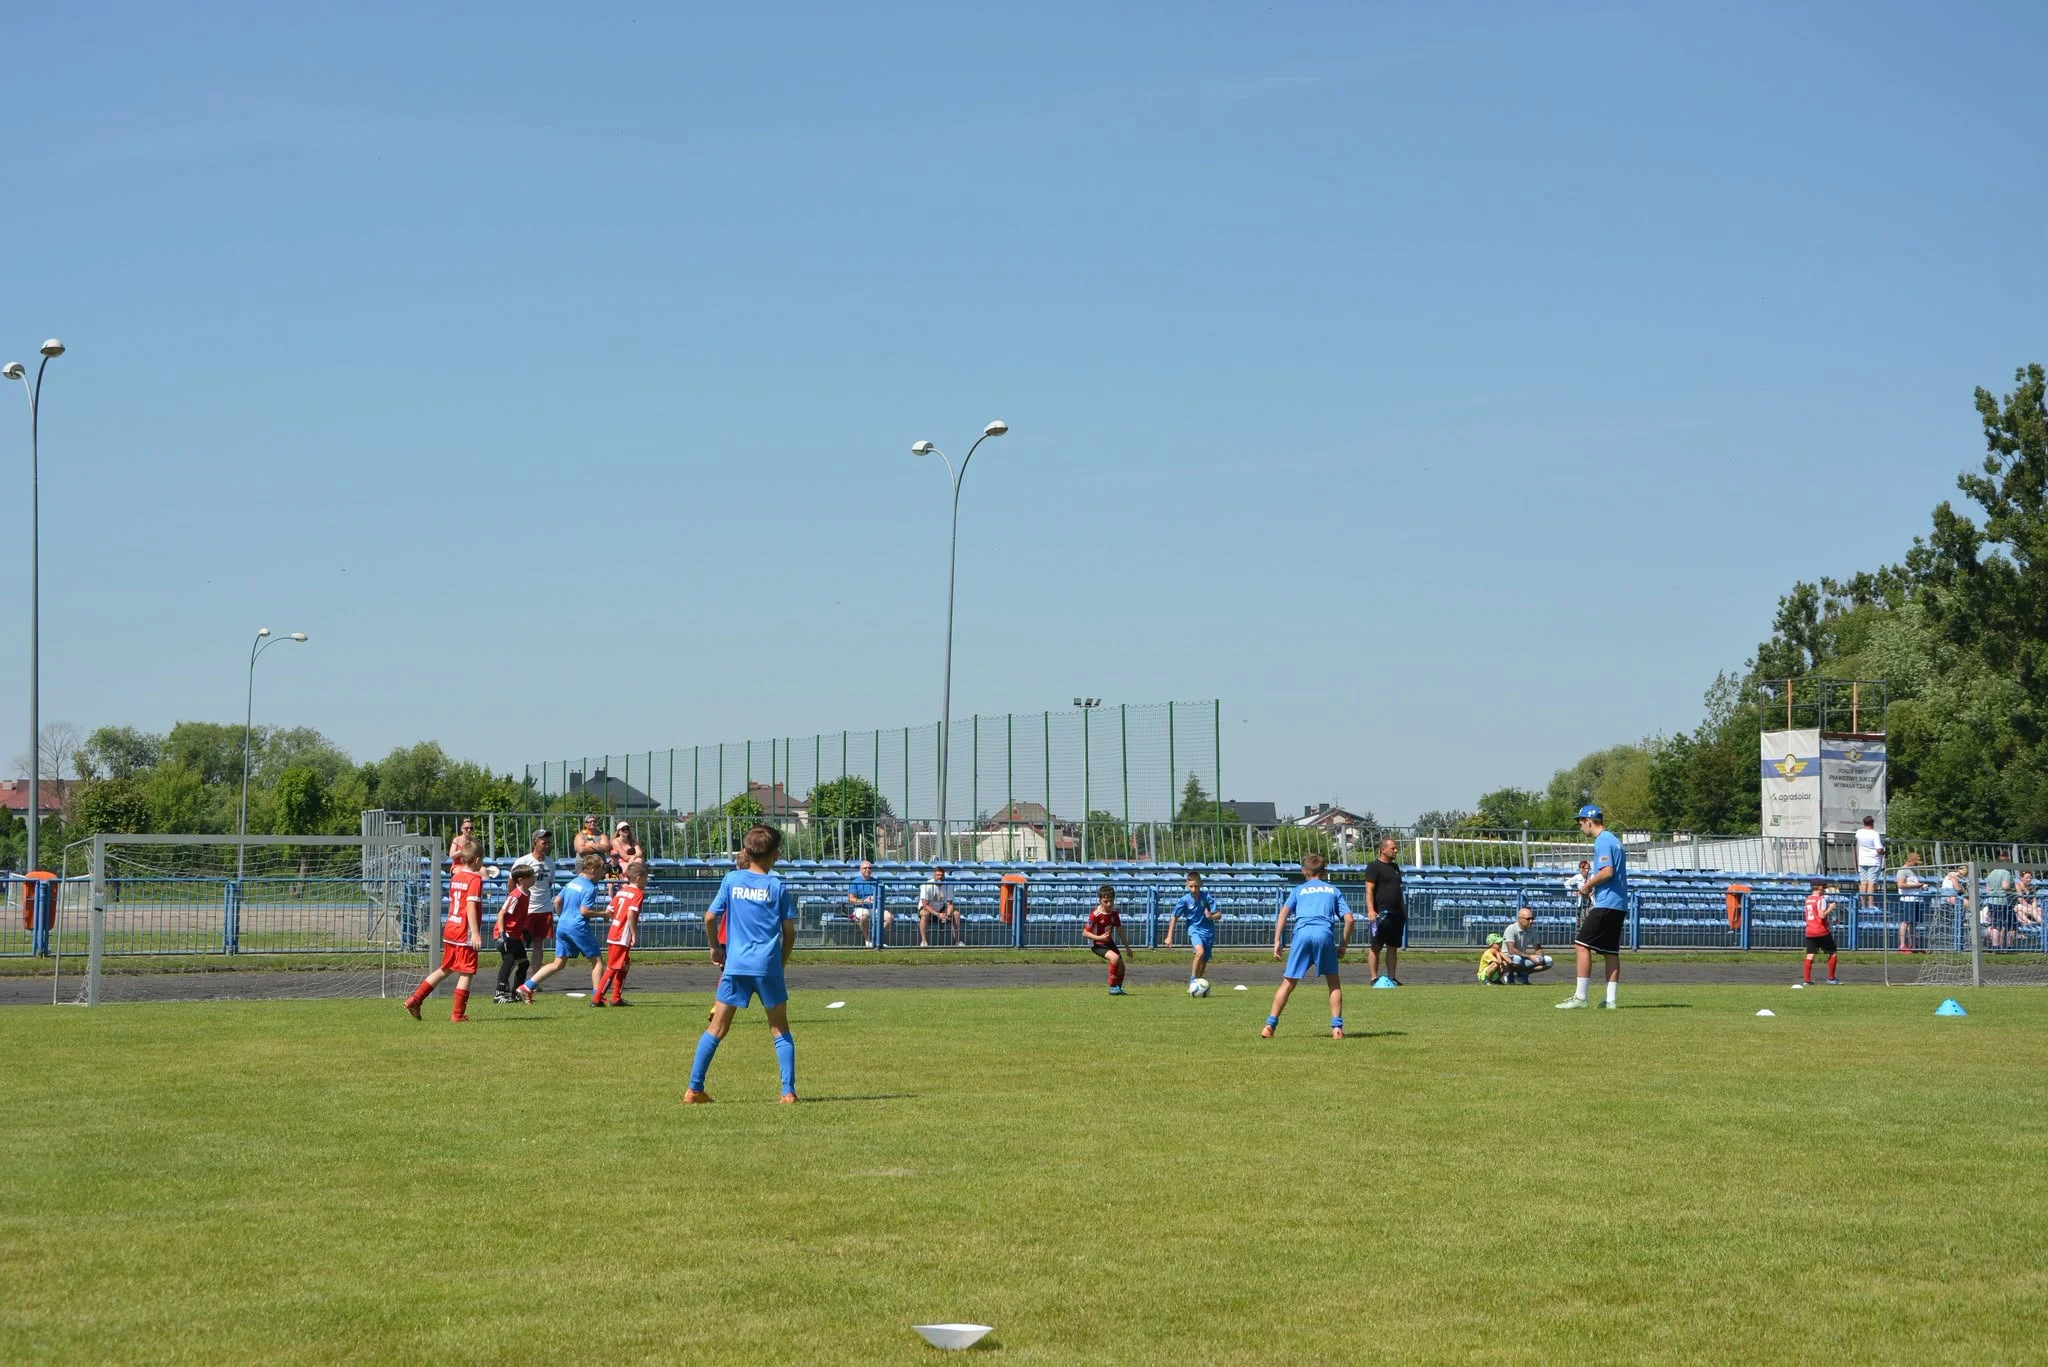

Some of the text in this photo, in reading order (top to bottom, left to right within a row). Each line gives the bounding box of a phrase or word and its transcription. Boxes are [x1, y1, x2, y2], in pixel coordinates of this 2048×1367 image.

[1778, 793, 1811, 802] agrosolar
[1300, 886, 1334, 896] ADAM
[615, 897, 625, 919] 7
